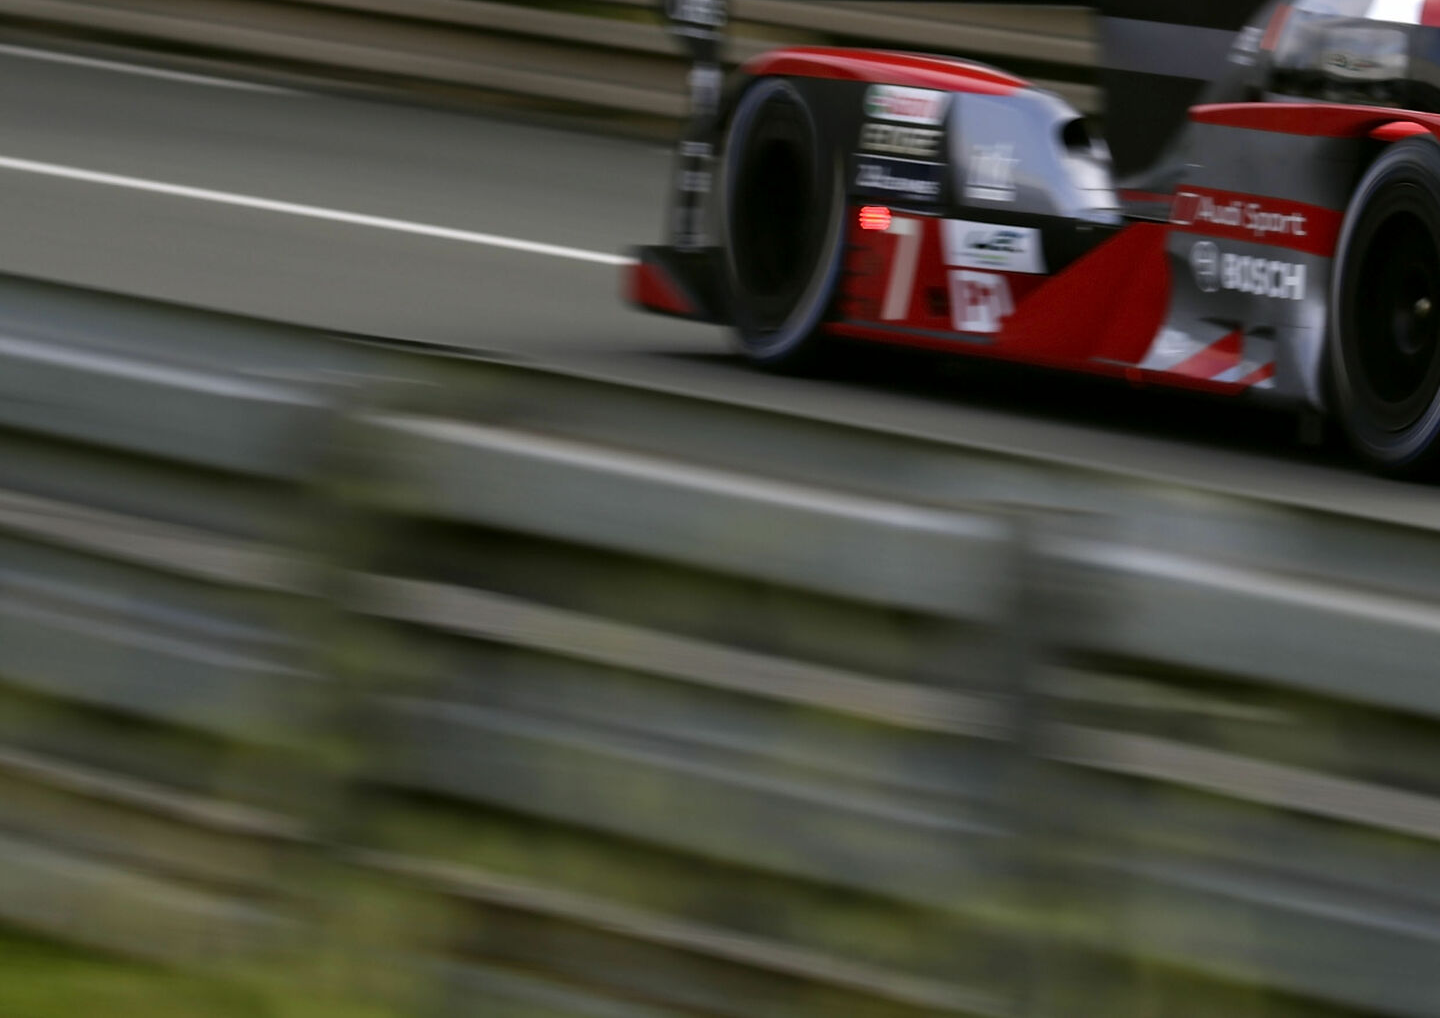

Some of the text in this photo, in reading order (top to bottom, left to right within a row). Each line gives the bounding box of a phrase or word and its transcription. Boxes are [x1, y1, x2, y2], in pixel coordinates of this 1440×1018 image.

[1198, 195, 1306, 237] Audi Sport
[1221, 253, 1306, 301] BOSCH
